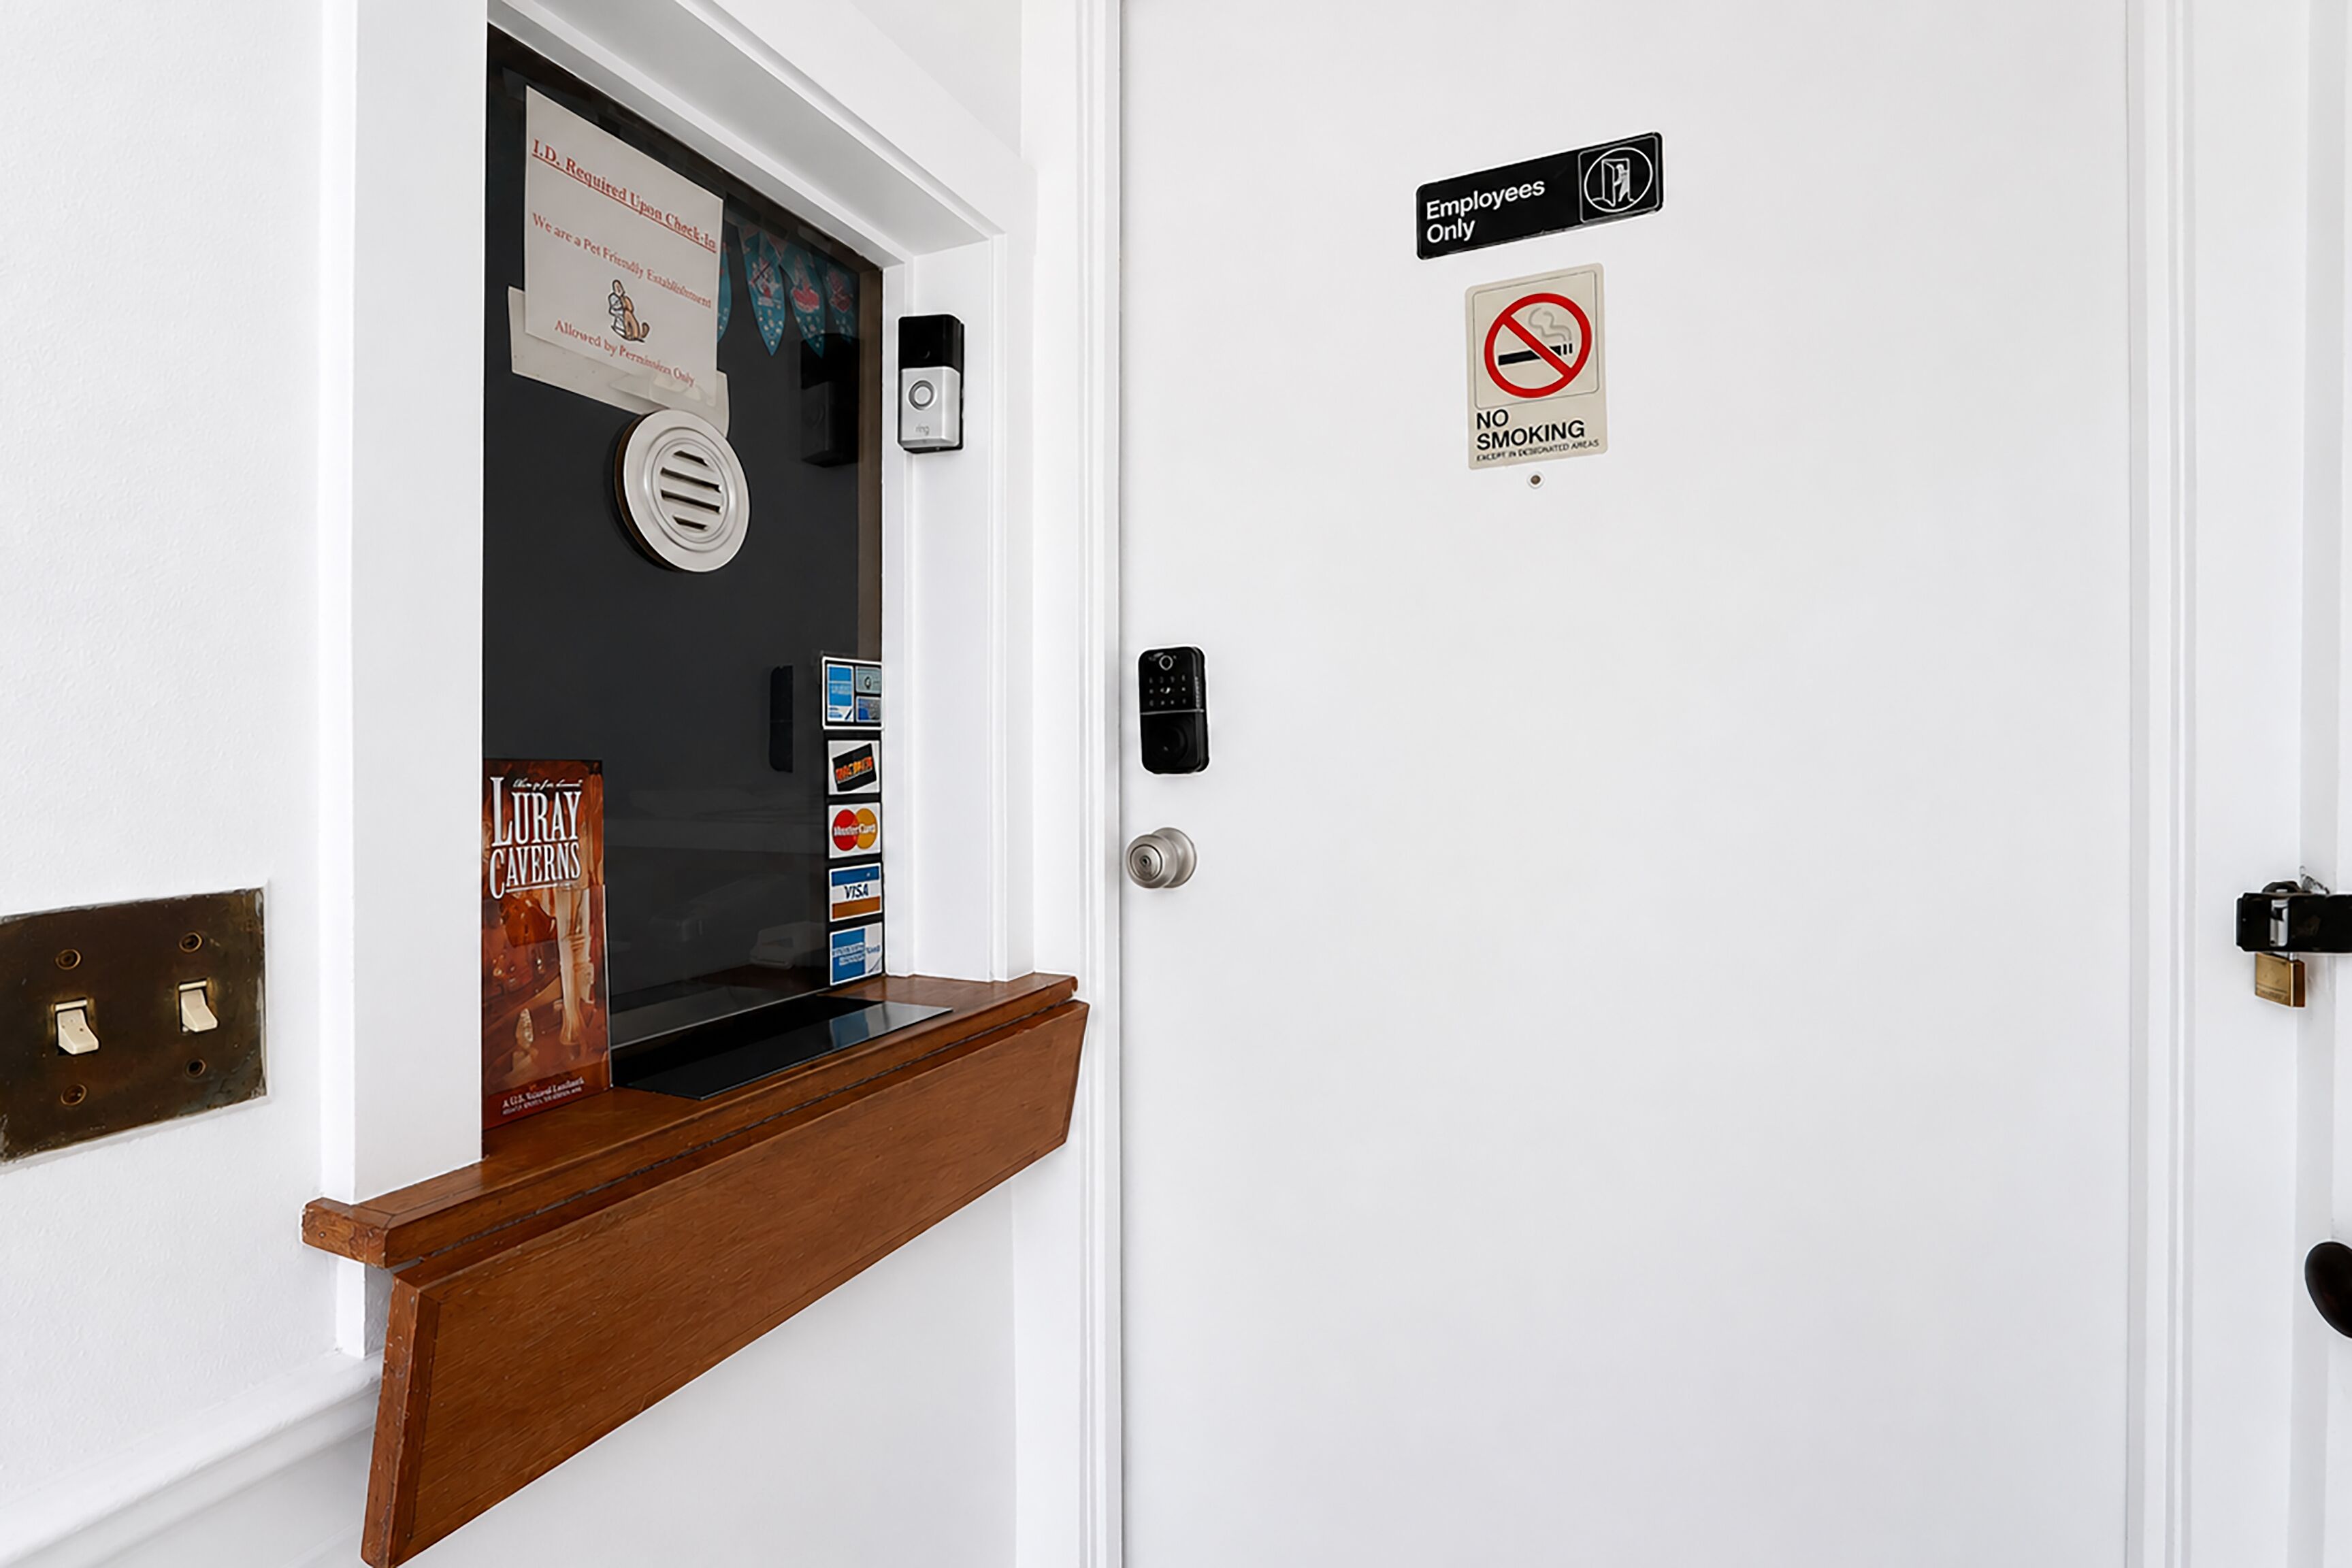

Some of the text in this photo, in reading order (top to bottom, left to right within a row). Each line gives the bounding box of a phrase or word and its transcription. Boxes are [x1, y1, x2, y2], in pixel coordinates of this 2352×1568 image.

[533, 139, 717, 249] I.D. Required Upon Check-In
[1426, 180, 1545, 220] Employees
[1426, 218, 1475, 243] Only
[533, 212, 711, 308] We are a Pet Friendly Establishment
[555, 320, 695, 387] Allowed by Permission Only
[1476, 409, 1509, 429] NO
[1476, 420, 1584, 451] SMOKING
[1476, 451, 1506, 461] EXCEPT
[1518, 444, 1569, 457] DESIGNATED
[1571, 439, 1599, 449] AREAS
[489, 777, 582, 847] LURAY
[489, 842, 581, 899] CAVERNS
[844, 883, 869, 899] VISA
